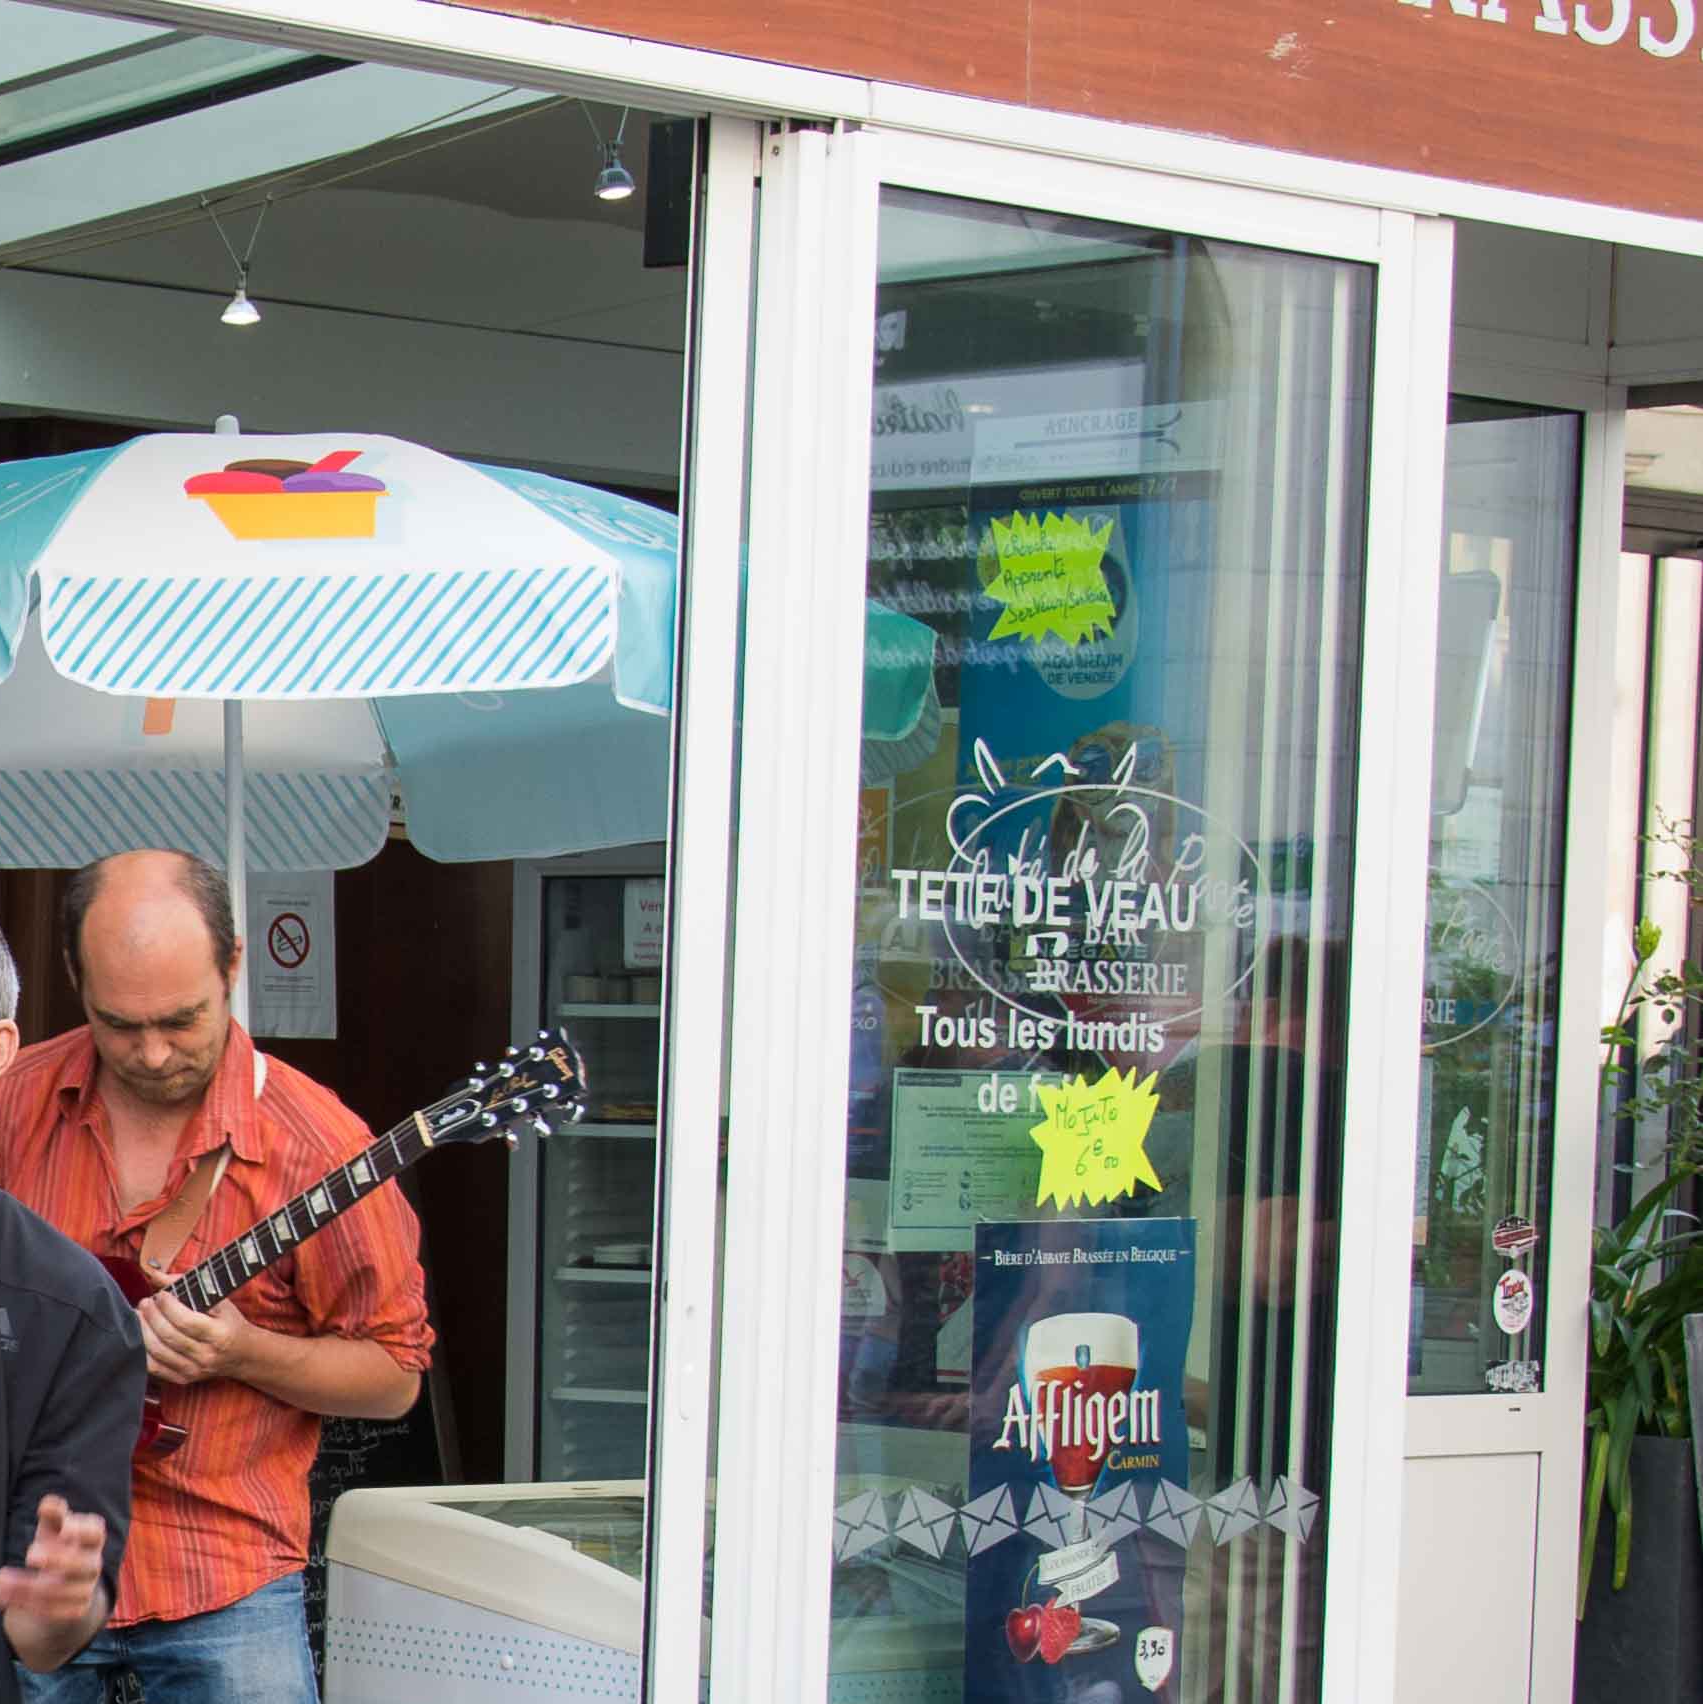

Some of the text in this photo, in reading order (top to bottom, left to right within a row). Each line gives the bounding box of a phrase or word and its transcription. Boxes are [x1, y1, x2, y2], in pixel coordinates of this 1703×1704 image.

[1046, 670, 1066, 686] DE
[891, 869, 1197, 932] TETE DE VEAU
[1083, 911, 1145, 946] BAR
[1033, 958, 1188, 995] BRASSERIE
[915, 1005, 997, 1049] Tous
[1008, 1008, 1056, 1050] les
[1066, 1010, 1166, 1053] lundis
[977, 1072, 1018, 1114] de
[992, 1379, 1162, 1463] Affligem
